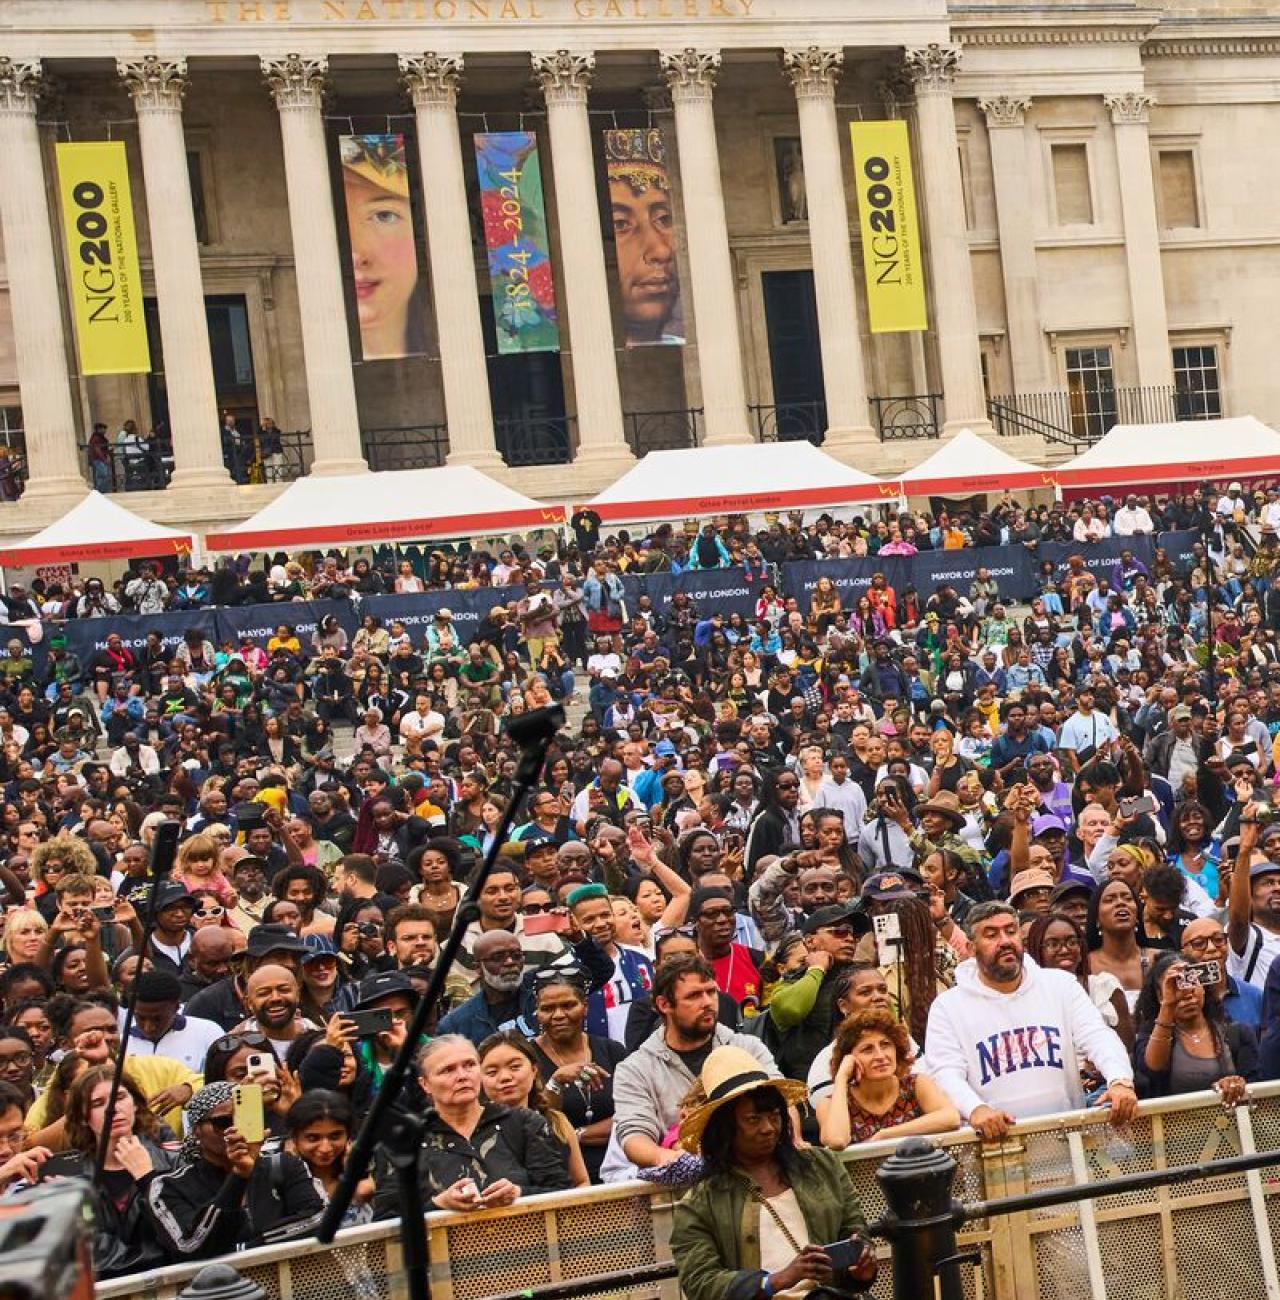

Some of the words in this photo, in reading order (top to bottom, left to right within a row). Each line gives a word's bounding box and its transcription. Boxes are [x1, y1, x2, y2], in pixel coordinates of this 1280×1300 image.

[205, 1, 292, 22] THE
[321, 0, 543, 21] NATIONAL
[573, 0, 753, 18] GALLERY
[108, 181, 120, 214] GALLERY
[897, 188, 906, 222] NATIONAL
[863, 156, 901, 286] NG200
[113, 216, 126, 254] NATIONAL
[72, 181, 119, 324] NG200
[118, 256, 126, 270] THE
[121, 285, 131, 310] YEARS
[123, 310, 133, 323] 200
[835, 578, 848, 588] OF
[930, 571, 963, 581] MAYOR
[963, 569, 976, 579] OF
[695, 590, 708, 601] OF
[709, 587, 750, 600] LONDON
[237, 626, 274, 640] MAYOR
[976, 1025, 1064, 1085] NIKE
